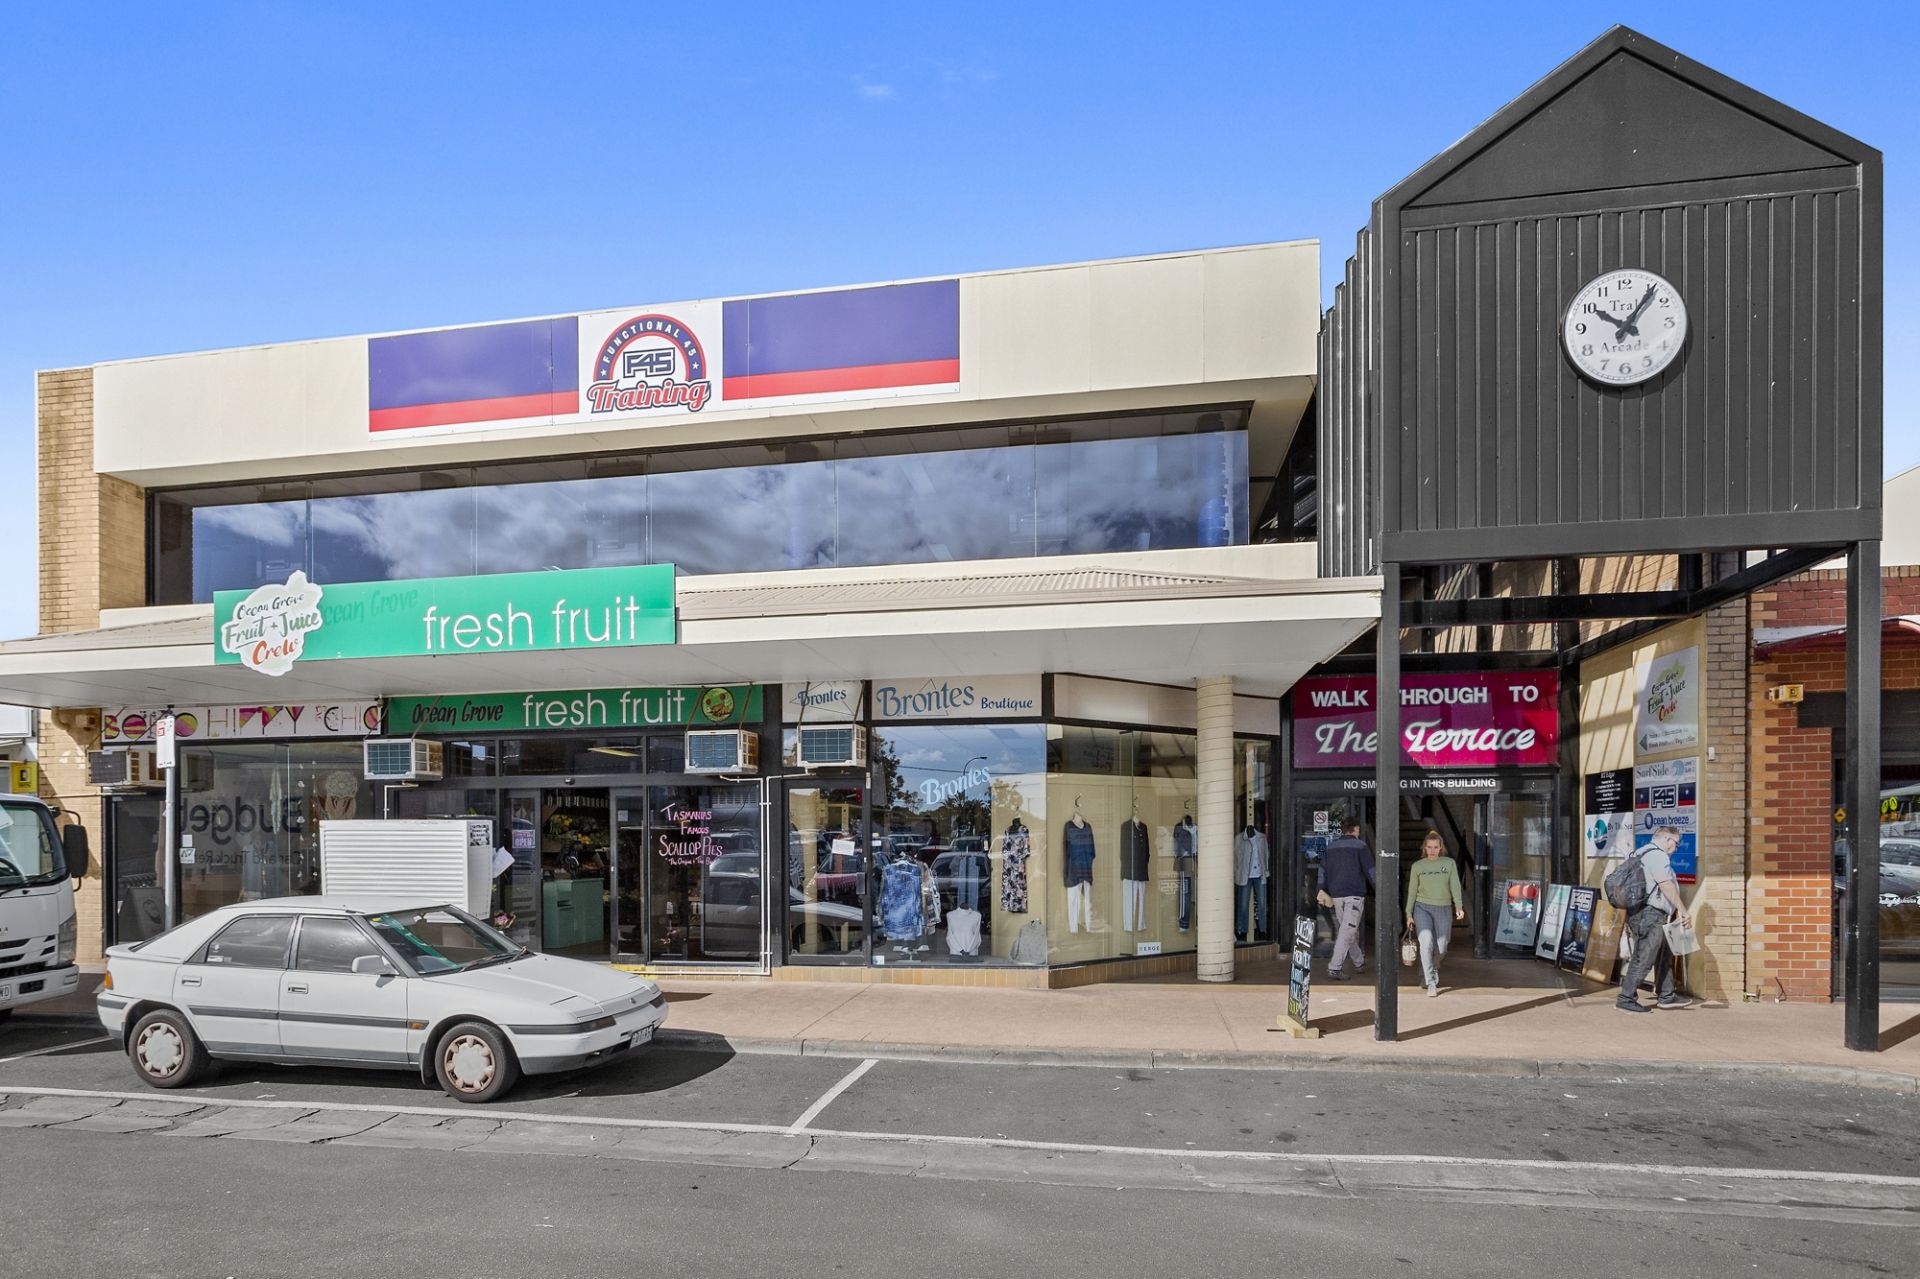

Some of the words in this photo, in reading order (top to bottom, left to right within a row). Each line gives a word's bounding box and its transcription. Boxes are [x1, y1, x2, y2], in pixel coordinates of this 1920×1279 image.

[1598, 286, 1608, 297] 11
[1617, 279, 1632, 290] 12
[1583, 303, 1597, 314] 10
[1659, 297, 1670, 308] 2
[1575, 323, 1586, 335] 9
[1664, 317, 1675, 328] 3
[603, 321, 679, 364] FUNCTIONAL
[683, 340, 696, 356] 45
[1582, 344, 1593, 356] 8
[624, 348, 675, 378] F45
[1600, 359, 1610, 371] 7
[1619, 363, 1631, 374] 6
[1641, 356, 1652, 367] 5
[587, 378, 711, 413] Training
[237, 603, 269, 620] Ocean
[272, 594, 304, 611] Grove
[225, 616, 273, 648] Fruit
[276, 611, 319, 637] Juice
[320, 602, 364, 626] cean
[423, 602, 533, 649] fresh
[552, 596, 640, 643] fruit
[798, 689, 847, 706] Brontes
[877, 682, 974, 717] Brontes
[981, 697, 1033, 712] Boutique
[1311, 690, 1369, 707] WALK
[1400, 686, 1488, 705] HROUGH
[1509, 685, 1539, 702] TO
[412, 703, 457, 725] Ocean
[461, 701, 504, 723] Grove
[523, 692, 606, 726] fresh
[620, 690, 685, 724] fruit
[1315, 719, 1377, 754] The
[1405, 718, 1536, 753] Terrace
[920, 765, 991, 805] Brontes
[1343, 780, 1359, 789] NO
[1410, 780, 1420, 788] IN
[1422, 779, 1446, 788] THIS
[1447, 778, 1496, 788] BUILDING
[1651, 785, 1676, 808] F45
[1608, 823, 1613, 832] By
[1668, 815, 1690, 825] breeze
[658, 834, 701, 856] SCALLOP
[1570, 889, 1594, 912] F45
